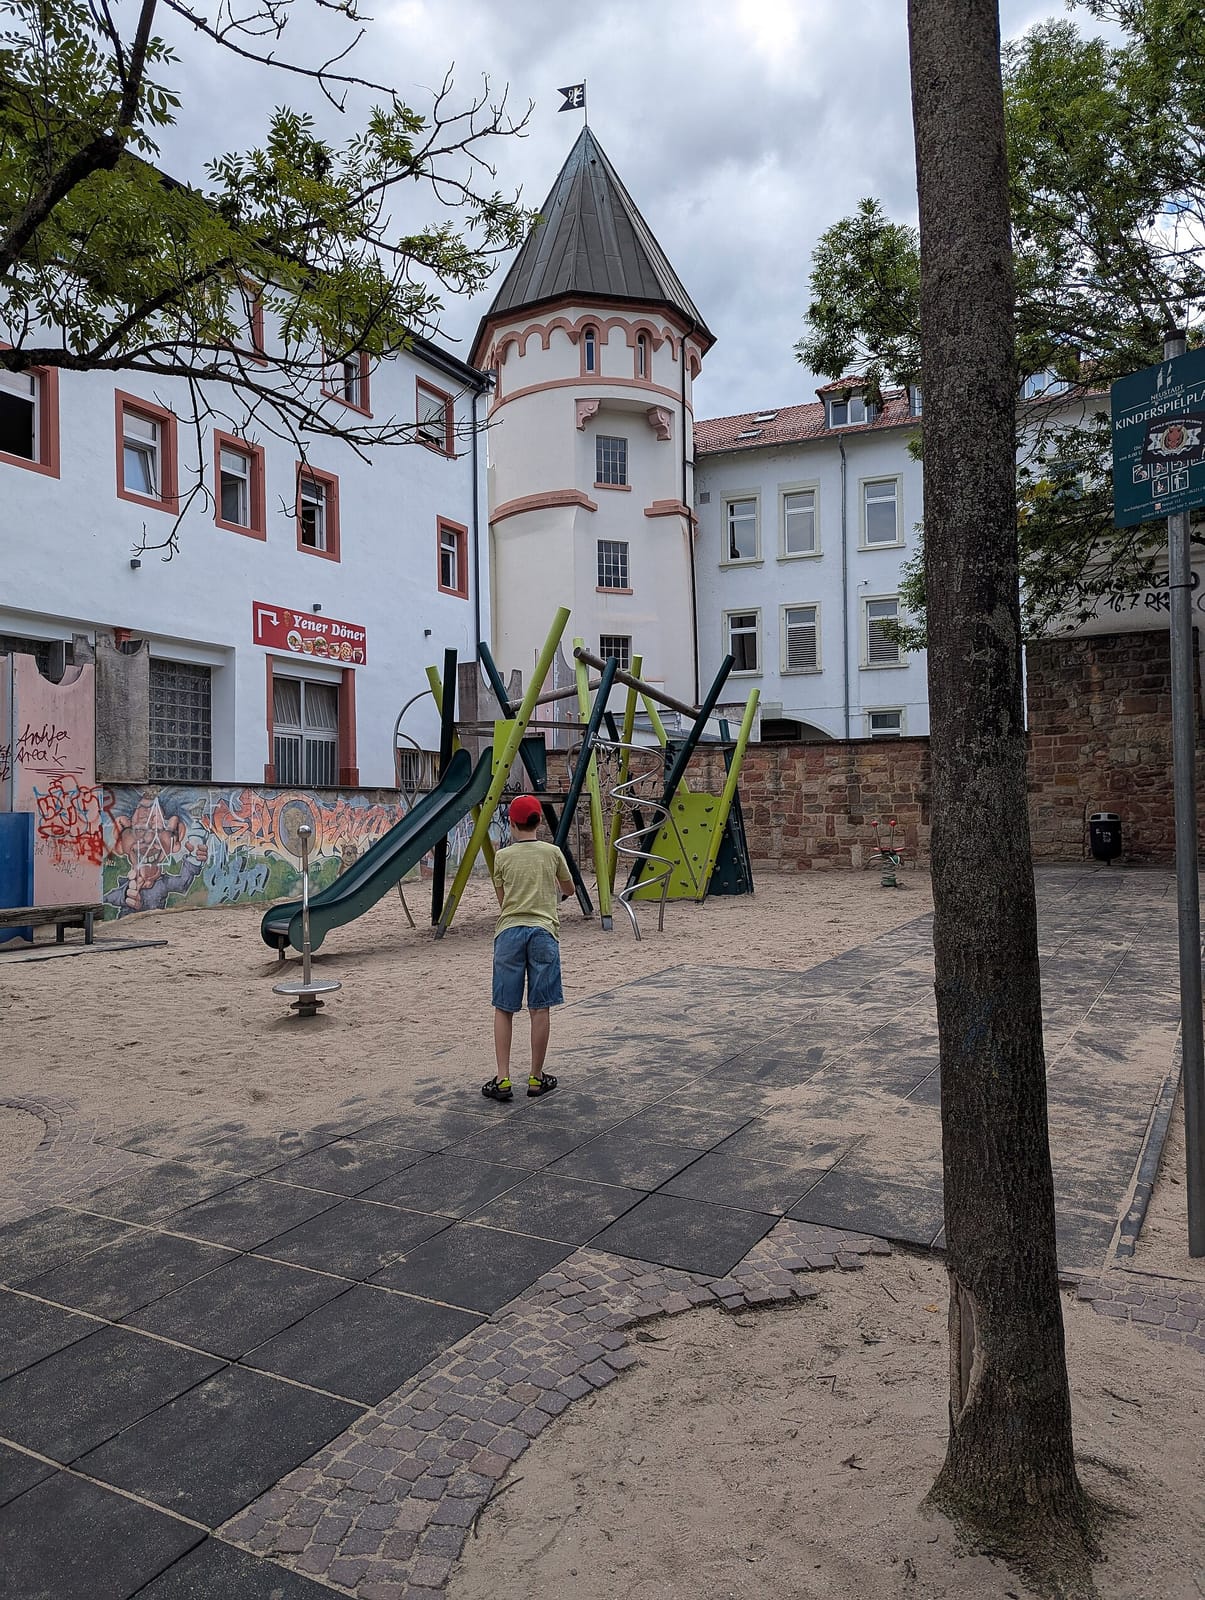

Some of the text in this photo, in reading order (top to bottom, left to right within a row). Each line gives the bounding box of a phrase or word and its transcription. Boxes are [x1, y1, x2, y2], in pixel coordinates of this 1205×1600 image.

[1151, 384, 1184, 401] NEUSTADT
[293, 614, 365, 641] Yener Döner
